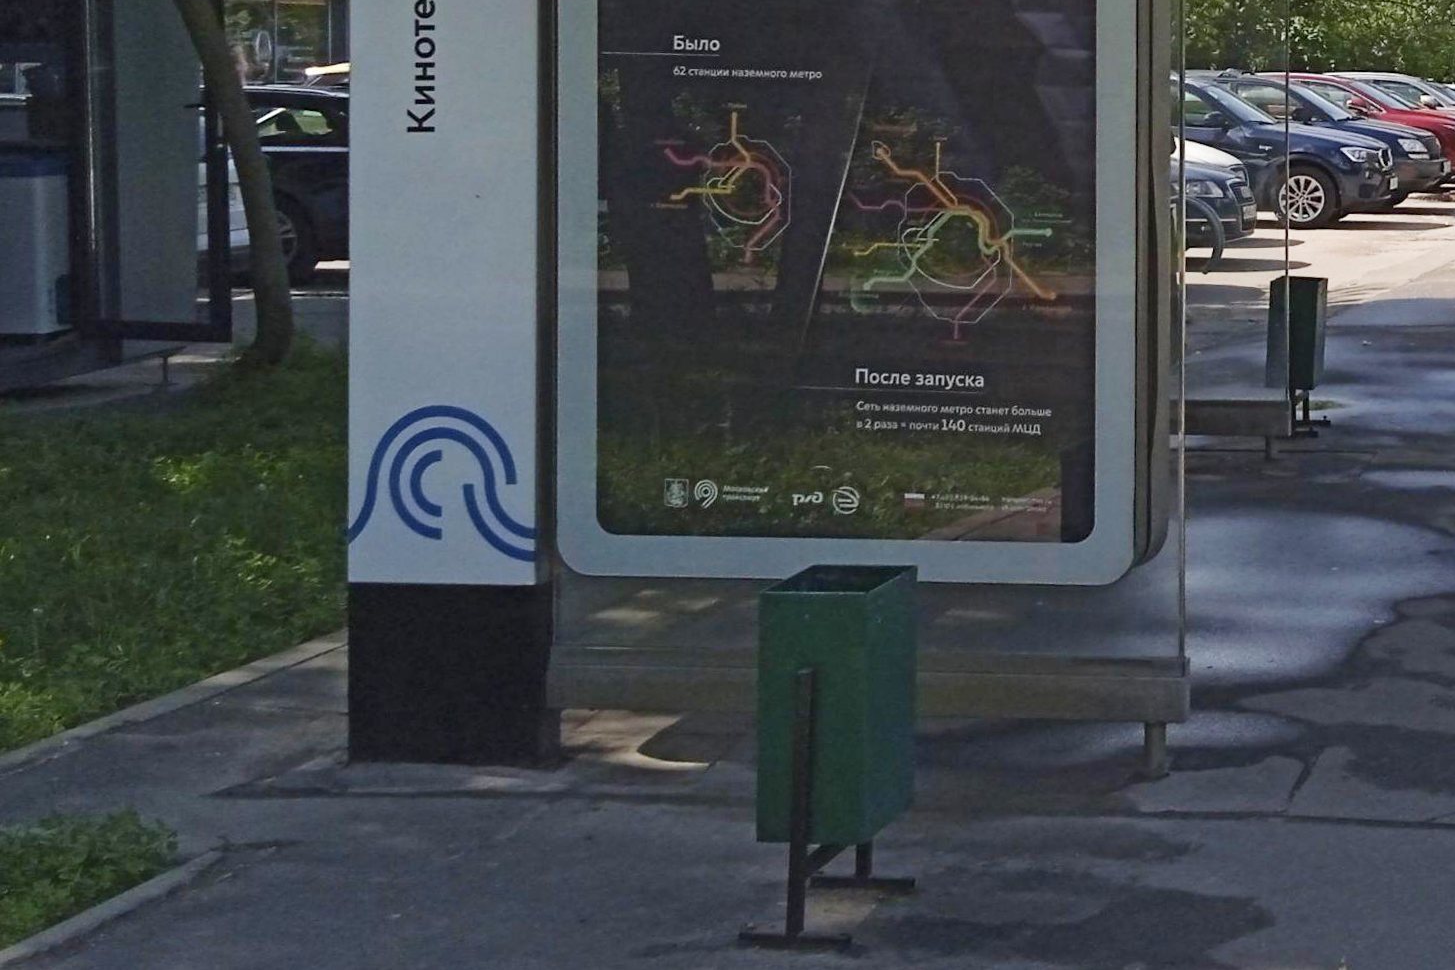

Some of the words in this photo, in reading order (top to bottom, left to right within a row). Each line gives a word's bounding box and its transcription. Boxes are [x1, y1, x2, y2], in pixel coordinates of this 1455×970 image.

[673, 35, 721, 51] Было
[673, 66, 686, 76] 62
[688, 68, 730, 78] станции
[731, 68, 787, 79] наземного
[789, 70, 823, 80] метро
[855, 368, 911, 385] После
[915, 372, 985, 390] запуска
[856, 401, 881, 411] Сеть
[883, 403, 938, 414] наземного
[940, 406, 974, 416] метро
[975, 406, 1009, 417] станет
[1011, 405, 1053, 417] больше
[856, 420, 863, 429] в
[865, 418, 872, 429] 2
[874, 420, 898, 431] раза
[909, 421, 939, 431] почти
[941, 419, 966, 432] 140
[968, 422, 1010, 434] станций
[1012, 423, 1042, 436] МЦД
